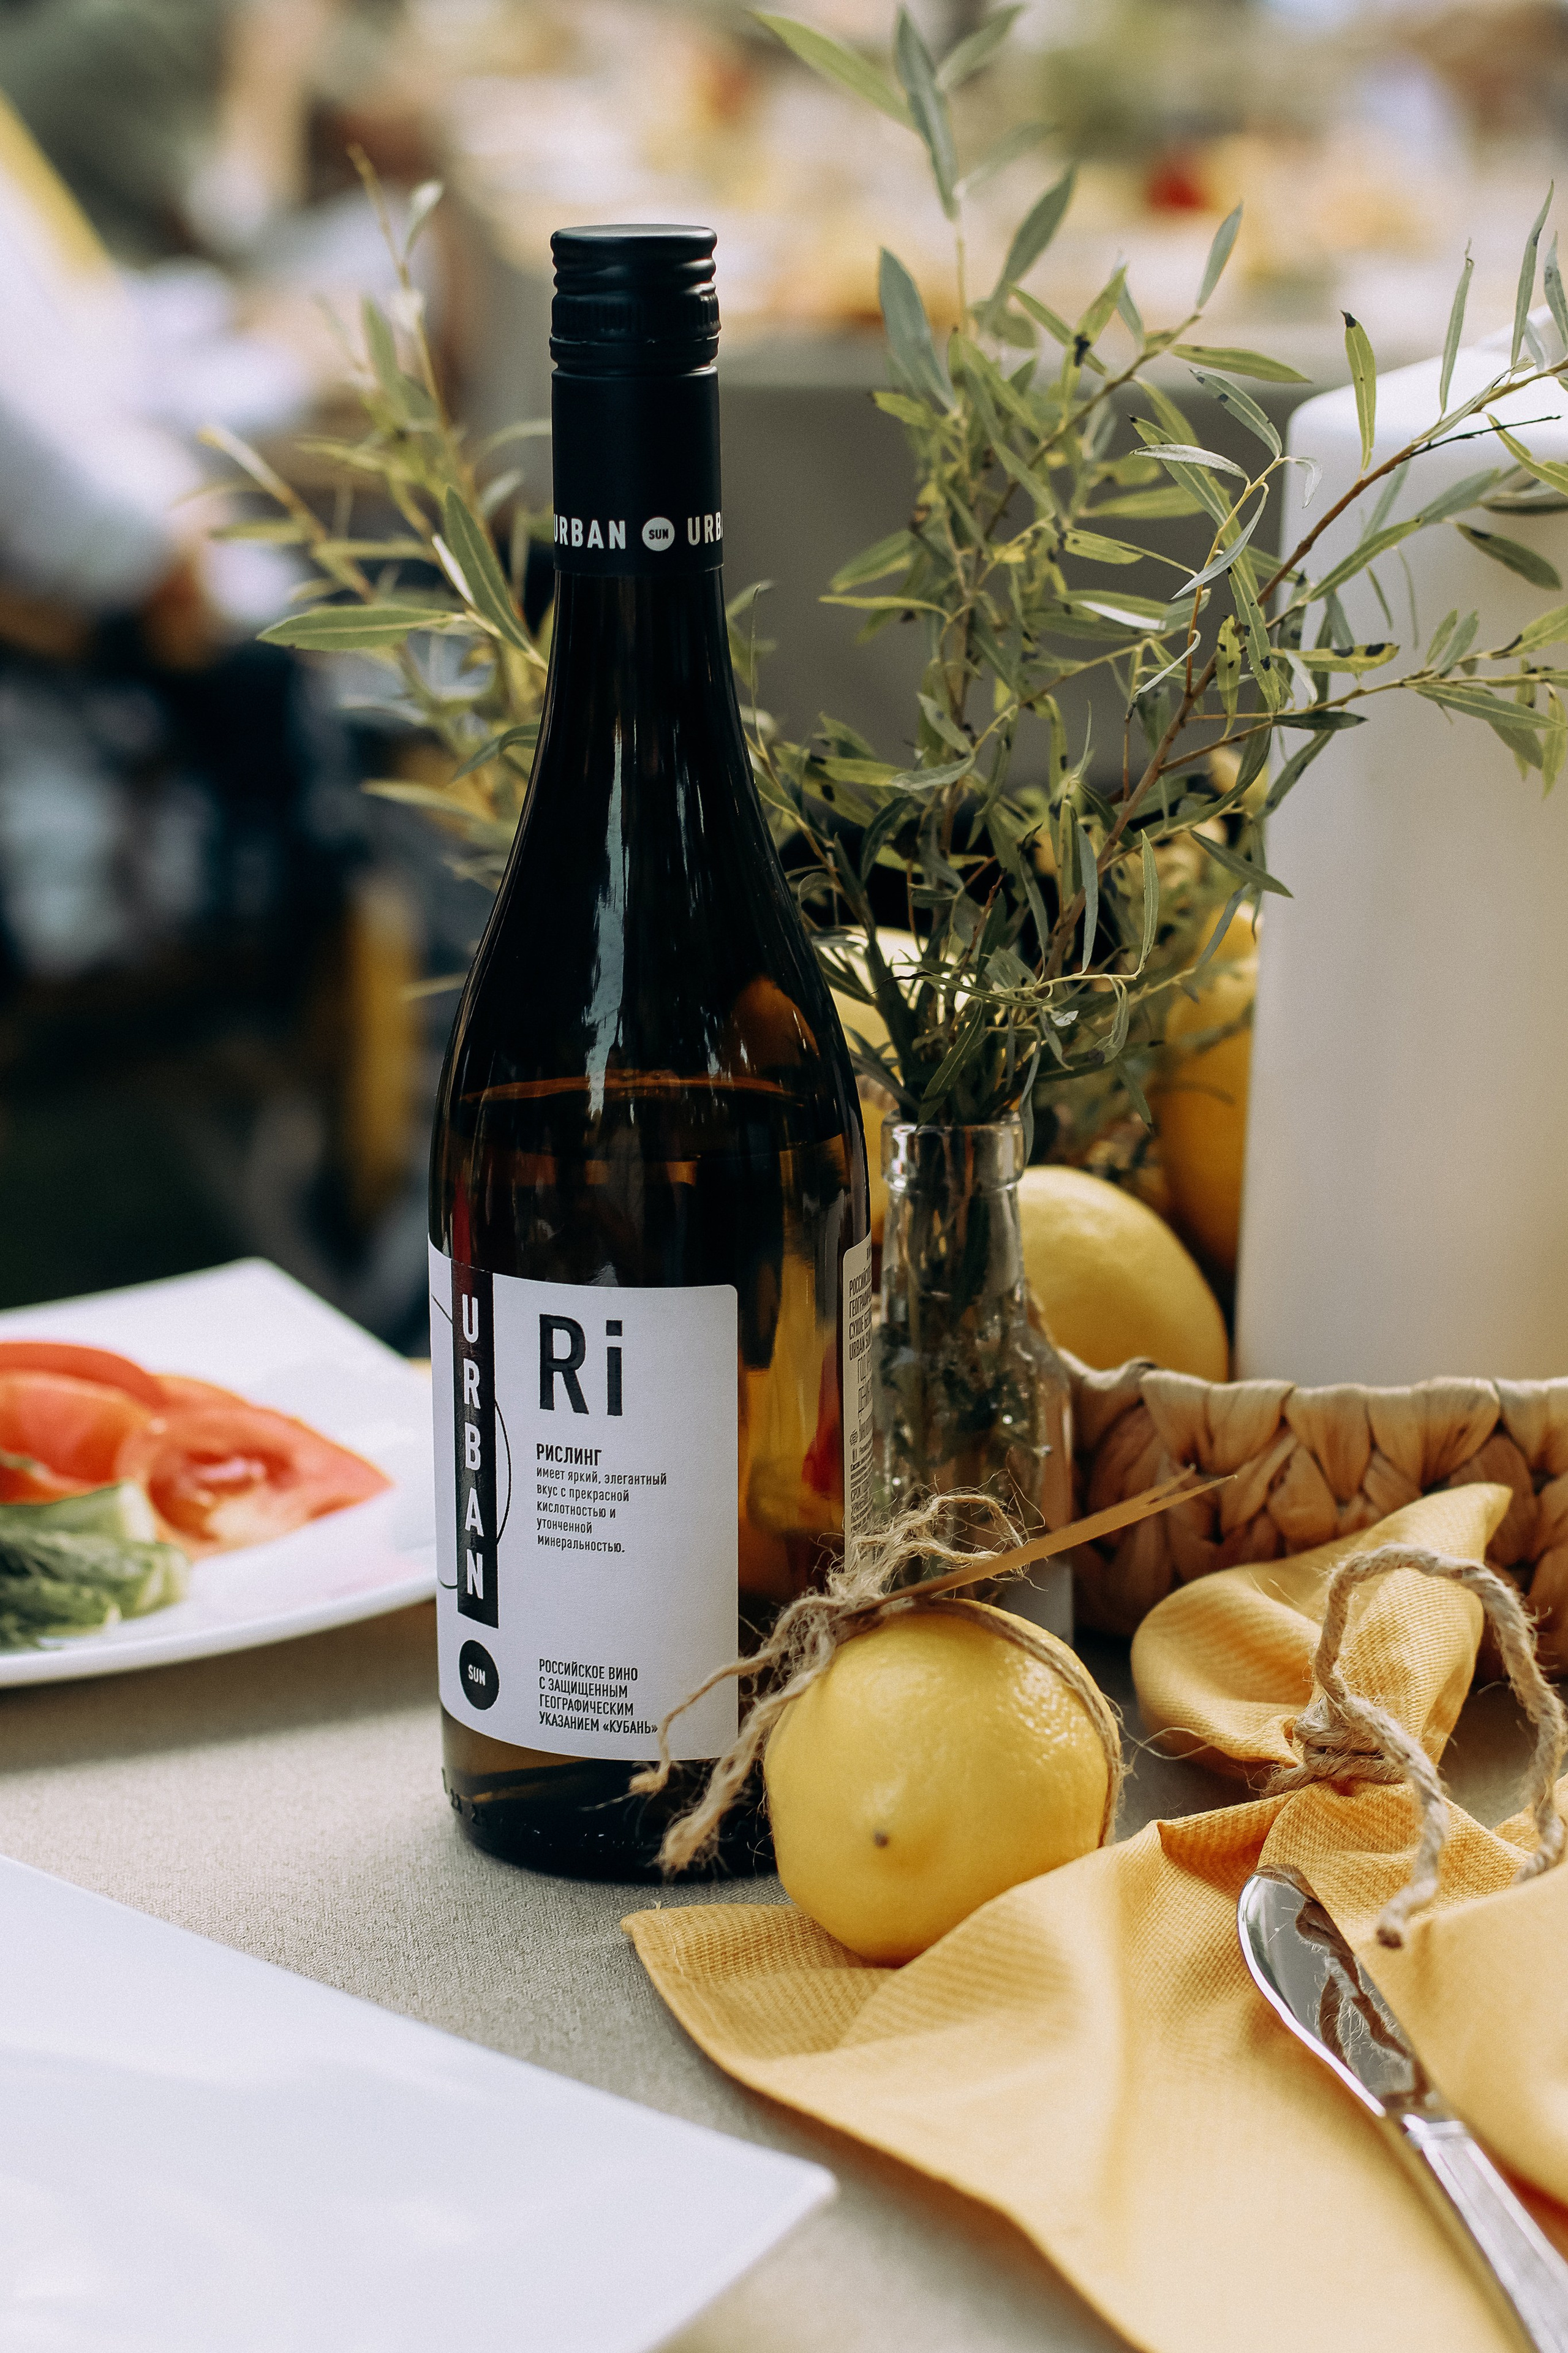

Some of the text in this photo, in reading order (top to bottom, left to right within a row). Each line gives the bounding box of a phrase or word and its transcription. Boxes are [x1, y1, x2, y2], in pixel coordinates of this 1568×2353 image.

[554, 511, 723, 550] URBAN SUN URB
[539, 1313, 623, 1416] Ri
[461, 1294, 484, 1600] URBAN
[537, 1443, 602, 1466] РИСЛИНГ
[537, 1467, 667, 1486] имеет яркий, элегантный
[537, 1484, 630, 1503] вкус с прекрасной
[537, 1500, 616, 1519] кислотностью и
[537, 1517, 593, 1534] утонченной
[537, 1535, 626, 1554] минеральностью.
[467, 1663, 487, 1687] SUN
[539, 1658, 638, 1682] РОССИЙСКОЕ ВИНО
[539, 1676, 628, 1698] С ЗАЩИЩЕННЫМ
[539, 1693, 634, 1716] ГЕОГРАФИЧЕСКИМ
[539, 1710, 658, 1734] УКАЗАНИЕМ «КУБАНЬ»
